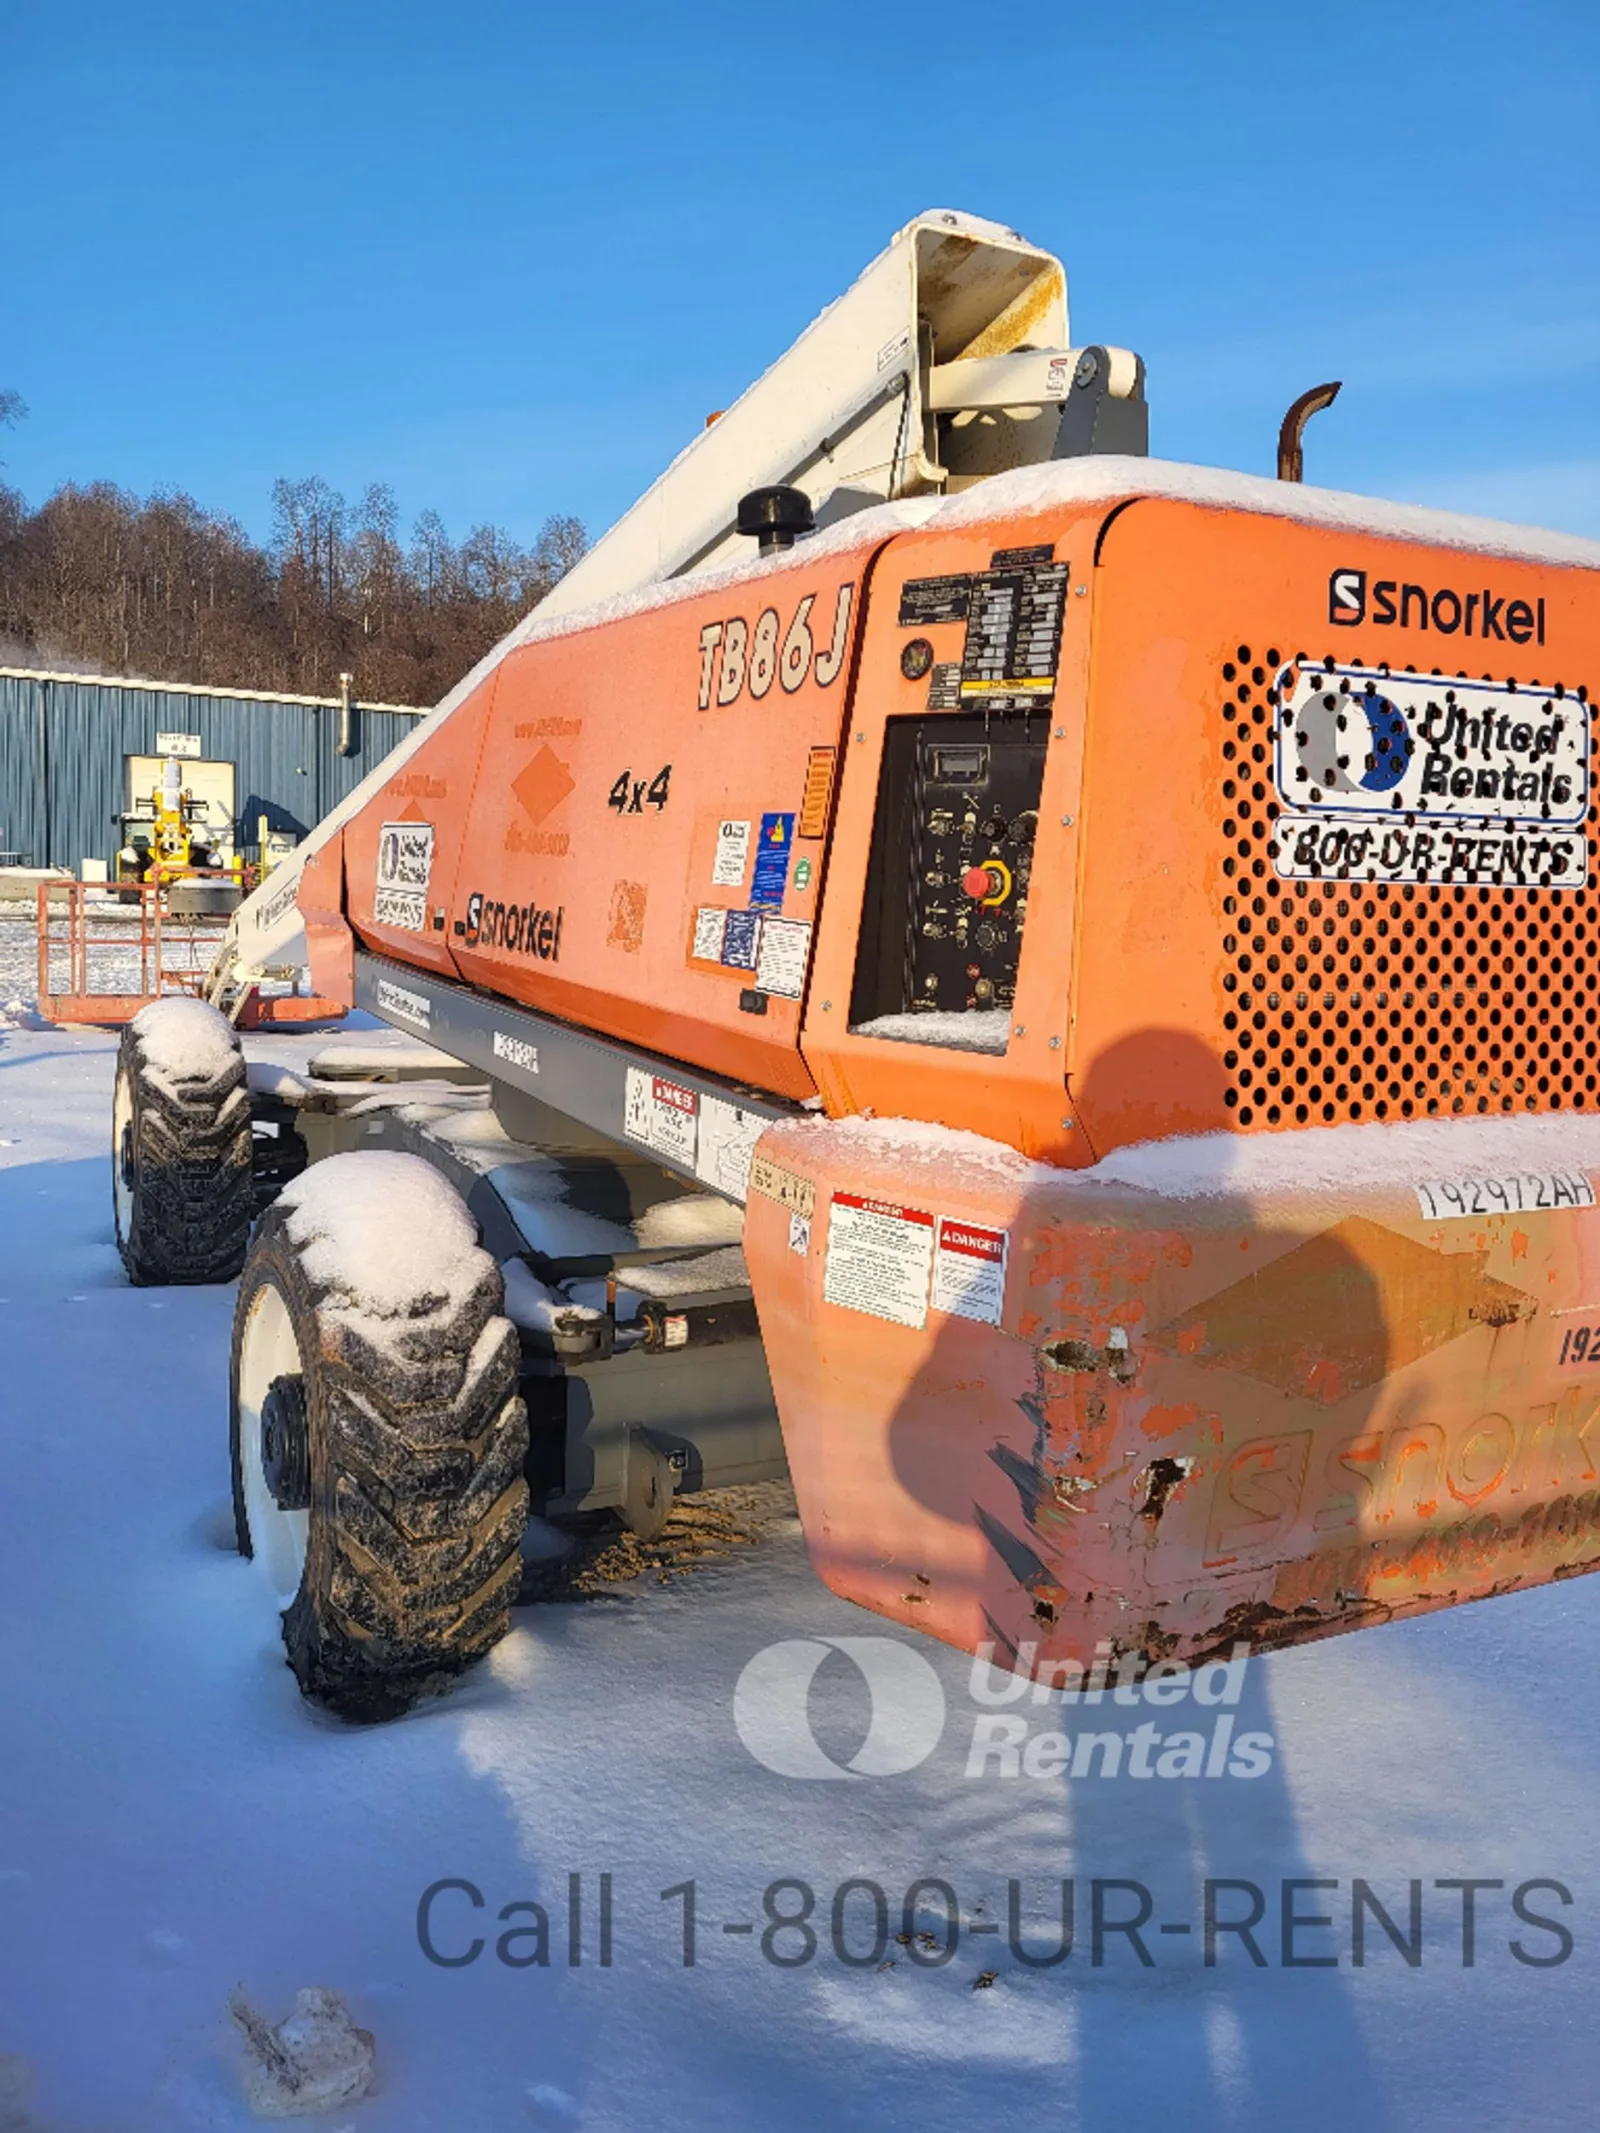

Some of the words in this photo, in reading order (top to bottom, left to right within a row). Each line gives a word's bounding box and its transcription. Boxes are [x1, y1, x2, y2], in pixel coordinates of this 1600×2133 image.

[1373, 580, 1545, 646] snorkel
[698, 581, 855, 711] TB86J
[1423, 701, 1560, 755] United
[608, 764, 672, 816] 4x4
[1421, 752, 1573, 804] Rentals
[482, 902, 565, 962] snorkel
[1419, 1172, 1594, 1217] 192972AH
[952, 1232, 1002, 1253] DANGER
